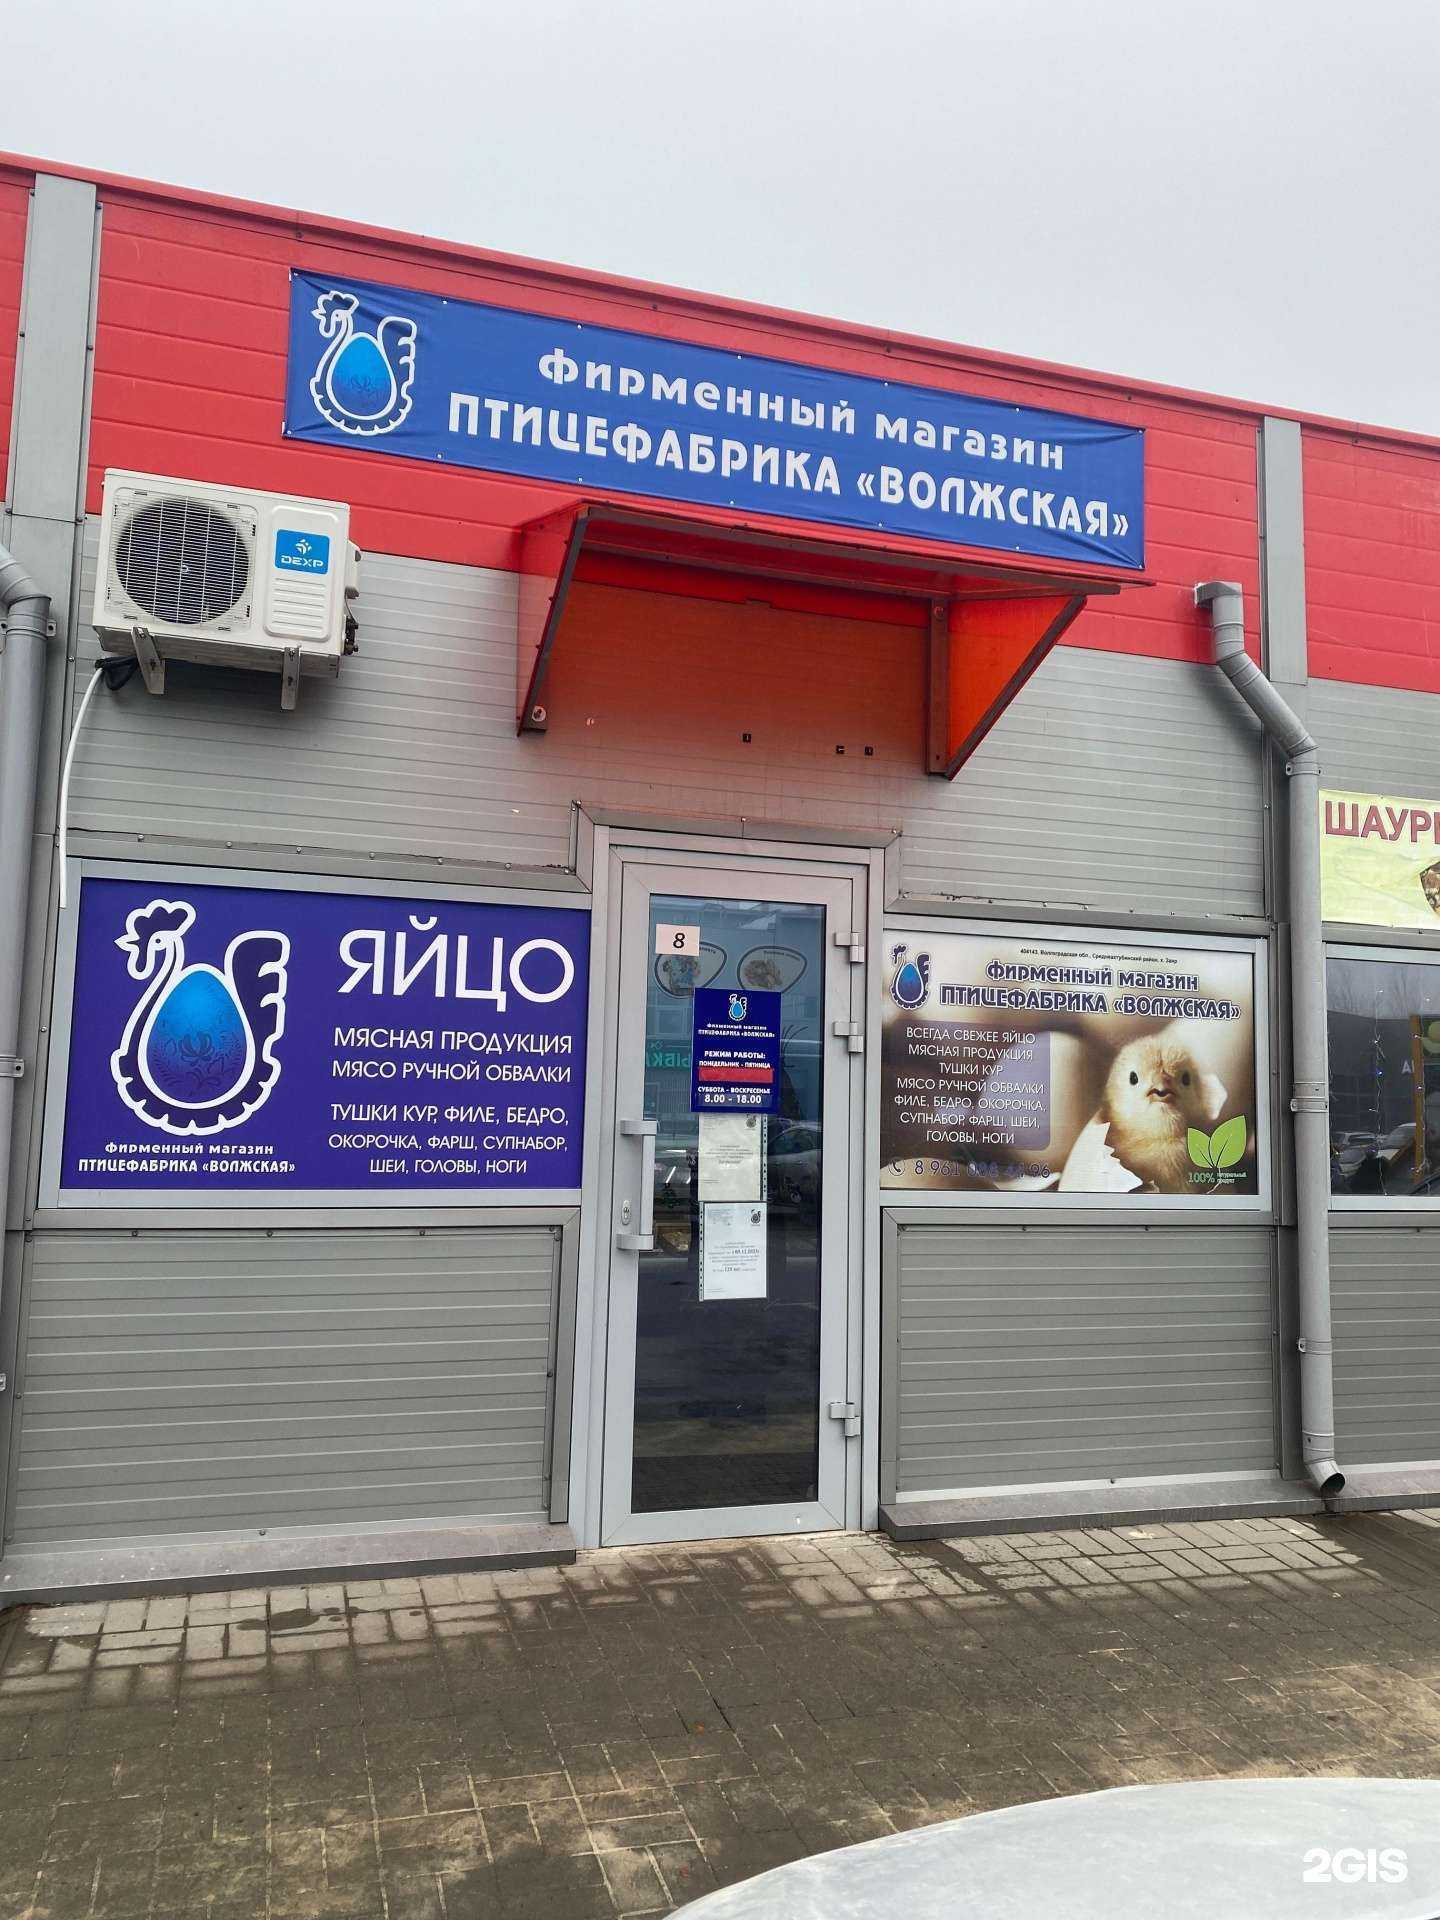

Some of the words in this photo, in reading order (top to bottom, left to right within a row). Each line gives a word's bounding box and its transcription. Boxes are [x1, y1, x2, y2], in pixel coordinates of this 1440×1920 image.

[875, 413, 1063, 470] магазин
[448, 392, 840, 495] ПТИЦЕФАБРИКА
[857, 465, 1129, 537] «ВОЛЖСКАЯ»
[281, 555, 323, 568] DEXP
[1324, 801, 1440, 845] ШАУР
[672, 932, 685, 949] 8
[337, 914, 575, 1012] ЯЙЦО
[1119, 971, 1199, 991] магазин
[940, 984, 1108, 1013] ПТИЦЕФАБРИКА
[1114, 995, 1241, 1019] «ВОЛЖСКАЯ»
[334, 1027, 433, 1050] МЯСНАЯ
[441, 1031, 572, 1056] ПРОДУКЦИЯ
[906, 1027, 950, 1041] ВСЕГДА
[953, 1029, 999, 1043] СВЕЖЕЕ
[1002, 1030, 1036, 1044] ЯЙЦО
[704, 1050, 731, 1058] РЕЖИМ
[733, 1051, 766, 1059] РАБОТЫ:
[908, 1044, 959, 1057] МЯСНАЯ
[963, 1046, 1033, 1061] ПРОДУКЦИЯ
[332, 1060, 397, 1079] МЯСО
[402, 1060, 479, 1081] РУЧНОЙ
[485, 1064, 571, 1083] ОБВАЛКИ
[698, 1060, 740, 1068] ПОНЕДЕЛЬНИК
[939, 1062, 978, 1075] ТУШКИ
[982, 1065, 1003, 1076] КУР
[897, 1077, 935, 1090] МЯСО
[939, 1079, 986, 1092] РУЧНОЙ
[990, 1082, 1045, 1094] ОБВАЛКИ
[704, 1094, 725, 1103] 8.00
[736, 1094, 762, 1104] 18.00
[894, 1094, 930, 1108] ФИЛЕ,
[933, 1096, 974, 1109] БЕДРО,
[978, 1098, 1046, 1112] ОКОРОЧКА,
[330, 1104, 397, 1121] ТУШКИ
[403, 1105, 438, 1124] КУР,
[444, 1106, 500, 1125] ФИЛЕ,
[506, 1107, 569, 1126] БЕДРО,
[900, 1112, 965, 1126] СУПНАБОР,
[968, 1115, 1007, 1128] ФАРШ,
[1010, 1117, 1040, 1129] ШЕИ,
[328, 1134, 422, 1150] ОКОРОЧКА,
[427, 1135, 478, 1150] ФАРШ,
[483, 1136, 568, 1152] СУПНАБОР,
[926, 1130, 978, 1144] ГОЛОВЫ,
[982, 1132, 1015, 1144] НОГИ
[209, 1143, 274, 1155] магазин
[78, 1158, 198, 1172] ПТИЦЕФАБРИКА
[202, 1160, 295, 1173] «ВОЛЖСКАЯ»
[370, 1159, 409, 1174] ШЕИ,
[414, 1159, 481, 1175] ГОЛОВЫ,
[486, 1160, 527, 1174] НОГИ
[914, 1160, 924, 1175] 8
[930, 1160, 960, 1177] 961
[1188, 1172, 1215, 1184] 100%
